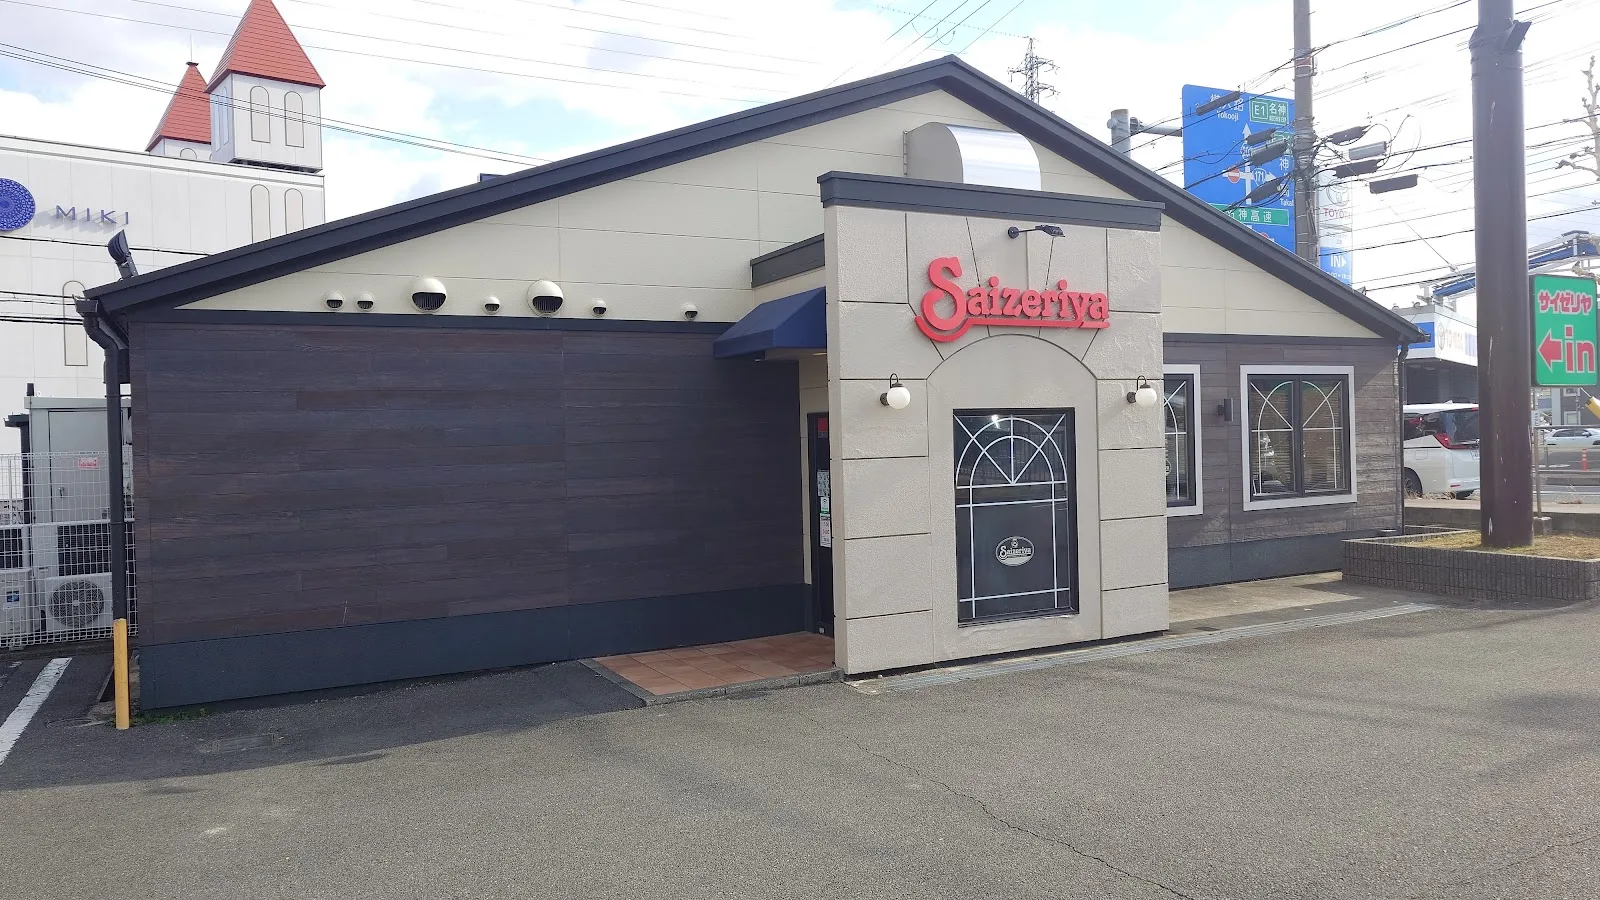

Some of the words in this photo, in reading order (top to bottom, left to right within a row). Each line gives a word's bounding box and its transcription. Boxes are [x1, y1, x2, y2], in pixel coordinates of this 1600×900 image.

[1254, 104, 1265, 116] E1
[1269, 102, 1287, 116] 名神
[1254, 171, 1264, 183] 171
[55, 205, 129, 225] MIKI
[1330, 255, 1341, 268] IN
[915, 256, 1110, 342] Saizeriya
[1538, 289, 1593, 315] サイゼリヤ
[1564, 324, 1596, 373] in
